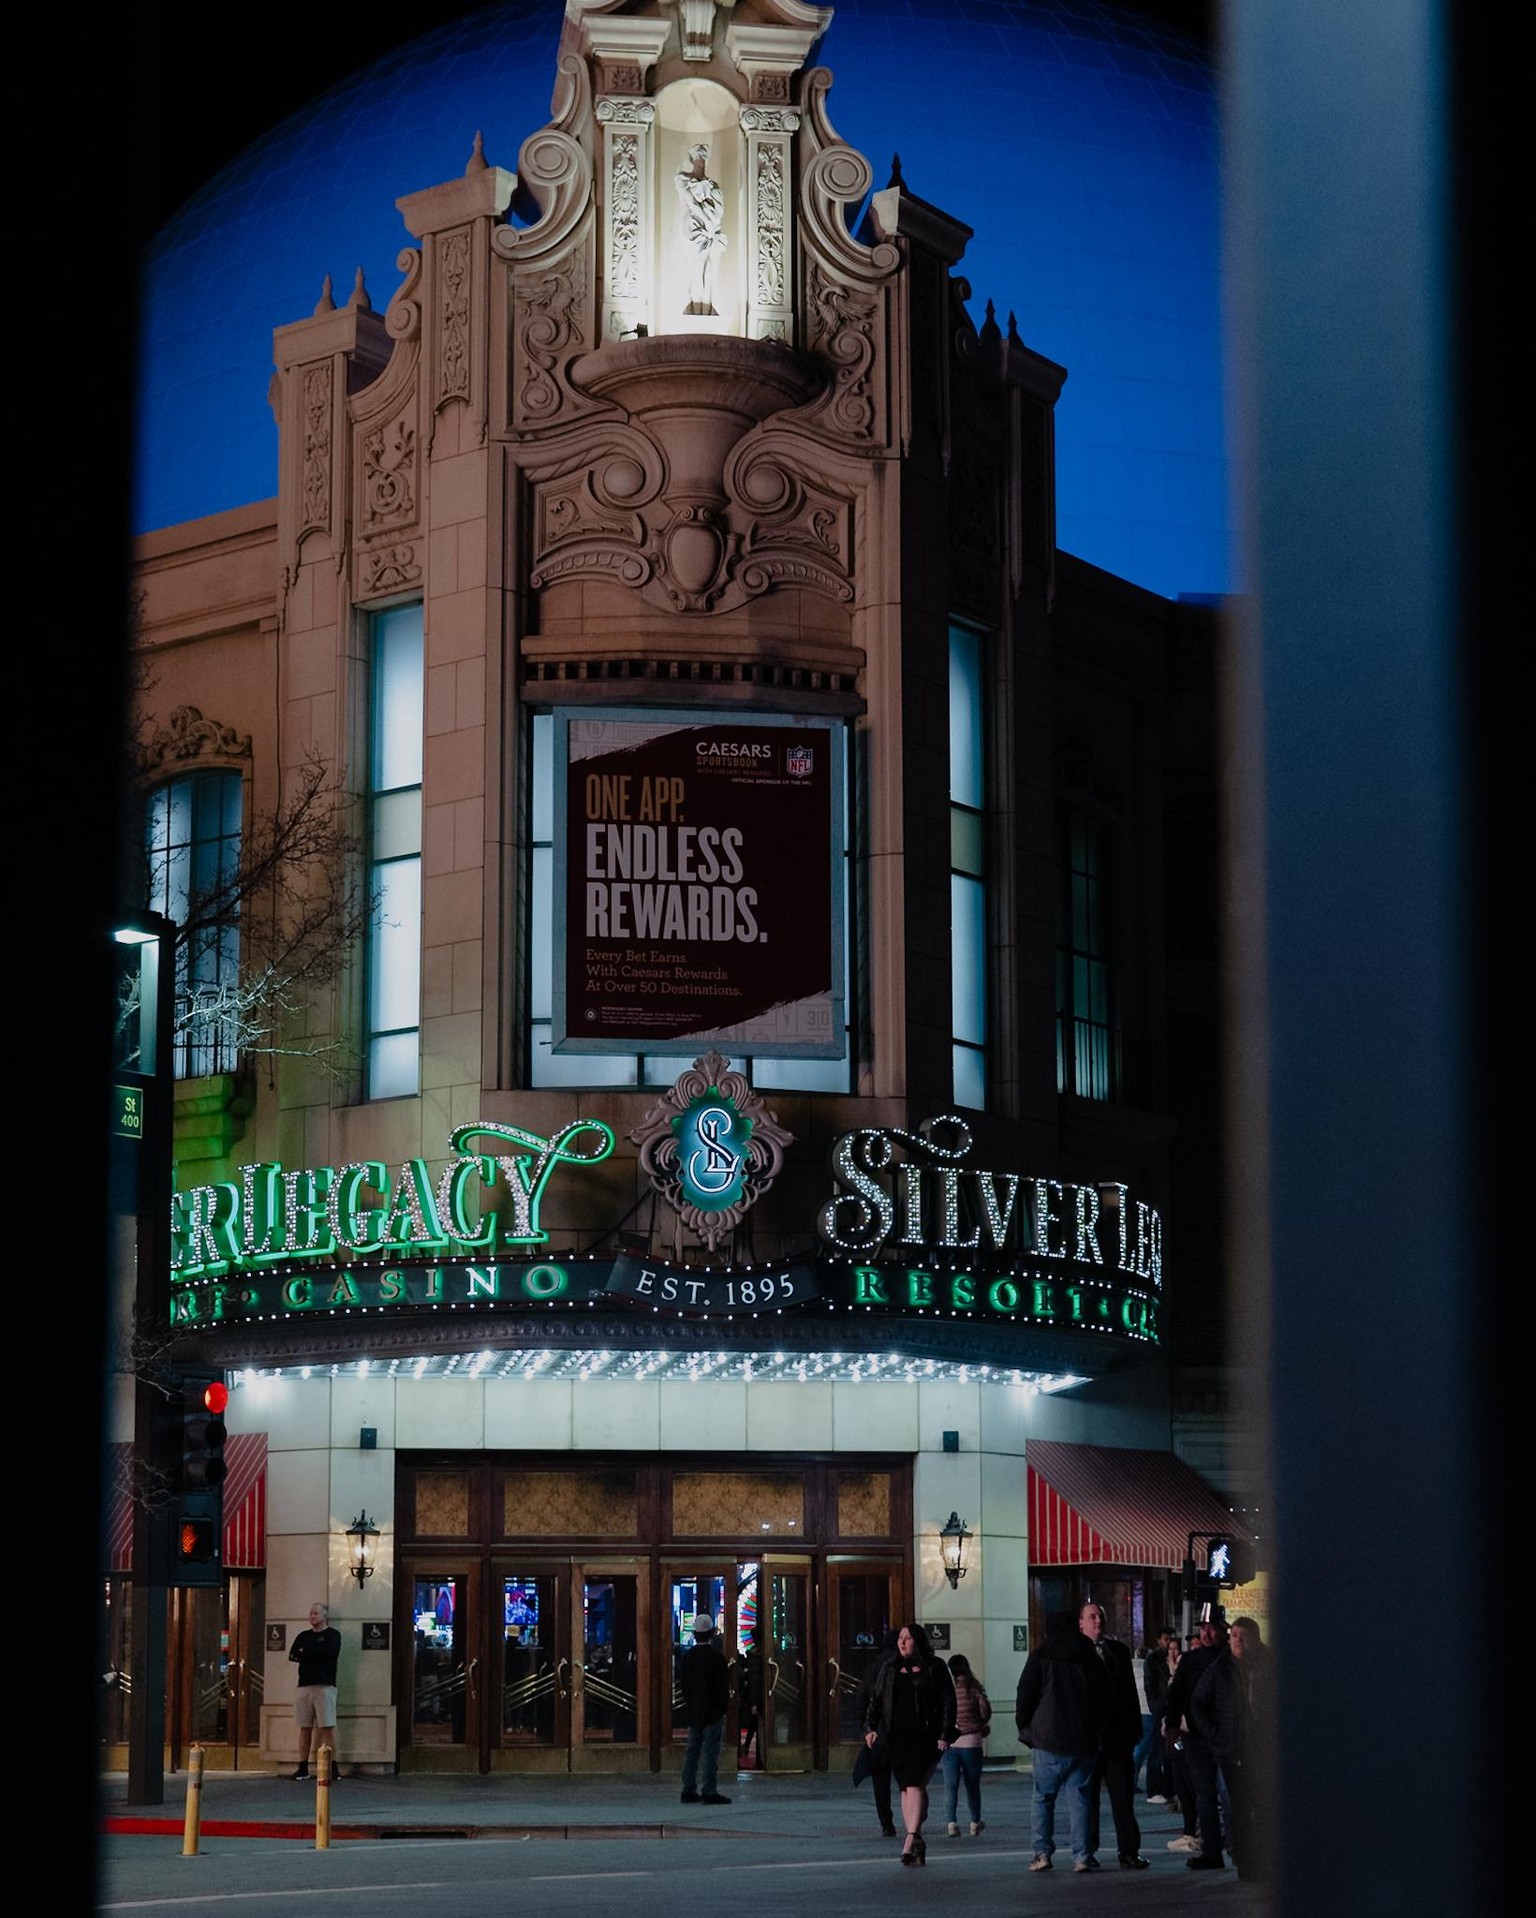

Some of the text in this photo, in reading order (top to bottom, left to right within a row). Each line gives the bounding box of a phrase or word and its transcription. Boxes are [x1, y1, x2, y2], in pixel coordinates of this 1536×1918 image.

[695, 742, 772, 758] CAESARS
[696, 756, 759, 768] SPORTSBOOK
[790, 759, 810, 773] NFL
[586, 774, 685, 823] ONE APP.
[586, 823, 744, 884] ENDLESS
[586, 882, 769, 944] REWARDS.
[585, 949, 687, 964] Every Bet Earns
[585, 964, 728, 980] With Caesars Rewards
[585, 979, 743, 997] At Over 50 Destinations.
[124, 1097, 136, 1112] St
[121, 1114, 140, 1128] 400
[239, 1118, 614, 1260] LEGACY
[821, 1114, 1104, 1264] SILVER
[281, 1264, 567, 1306] CASINO
[635, 1269, 794, 1306] EST. 1895
[856, 1267, 1088, 1321] RESORT
